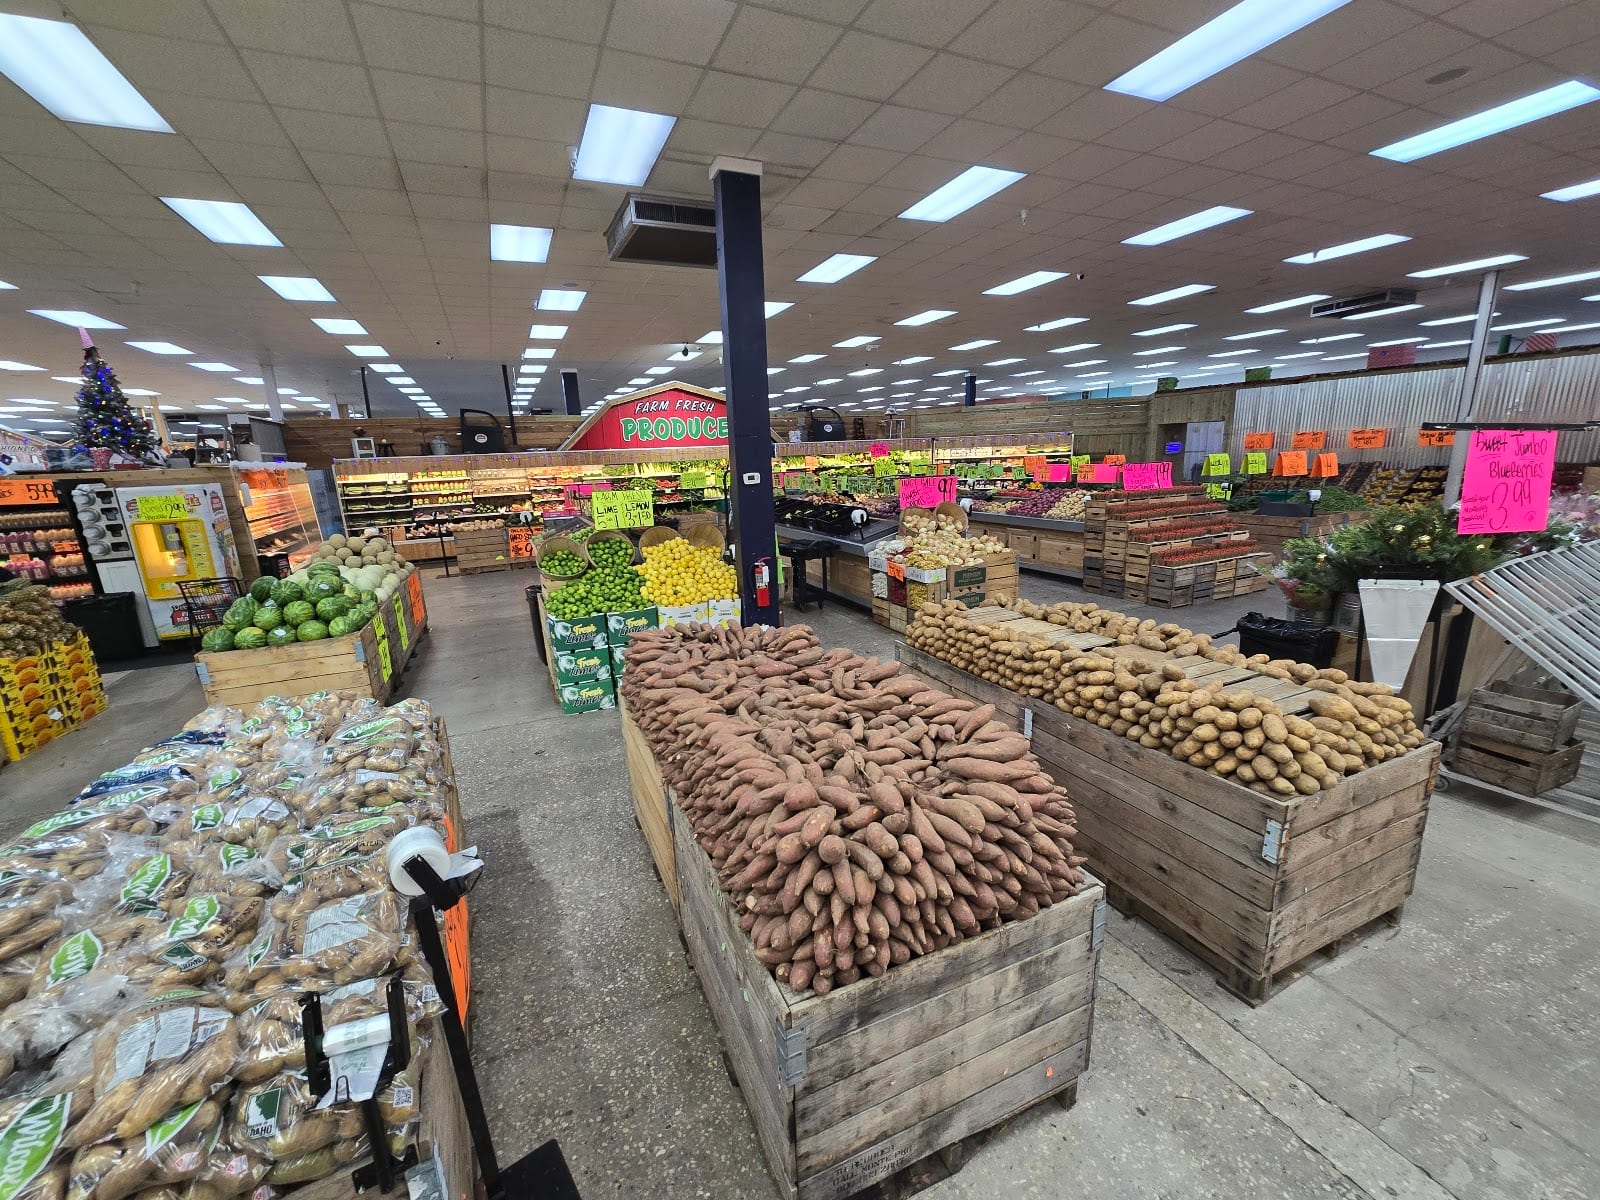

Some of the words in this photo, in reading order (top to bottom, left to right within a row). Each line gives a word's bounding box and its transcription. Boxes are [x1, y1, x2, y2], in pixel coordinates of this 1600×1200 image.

[634, 400, 670, 414] FARM
[675, 399, 715, 413] FRESH
[620, 416, 728, 441] PRODUCE
[1510, 433, 1548, 456] Jumbo
[595, 491, 619, 501] FARM
[621, 490, 648, 501] FRESH
[596, 505, 619, 515] LIME
[625, 500, 650, 512] LEMON
[625, 617, 649, 628] Fresh
[572, 623, 597, 636] Fresh
[576, 656, 602, 669] Fresh
[579, 687, 604, 699] Fresh
